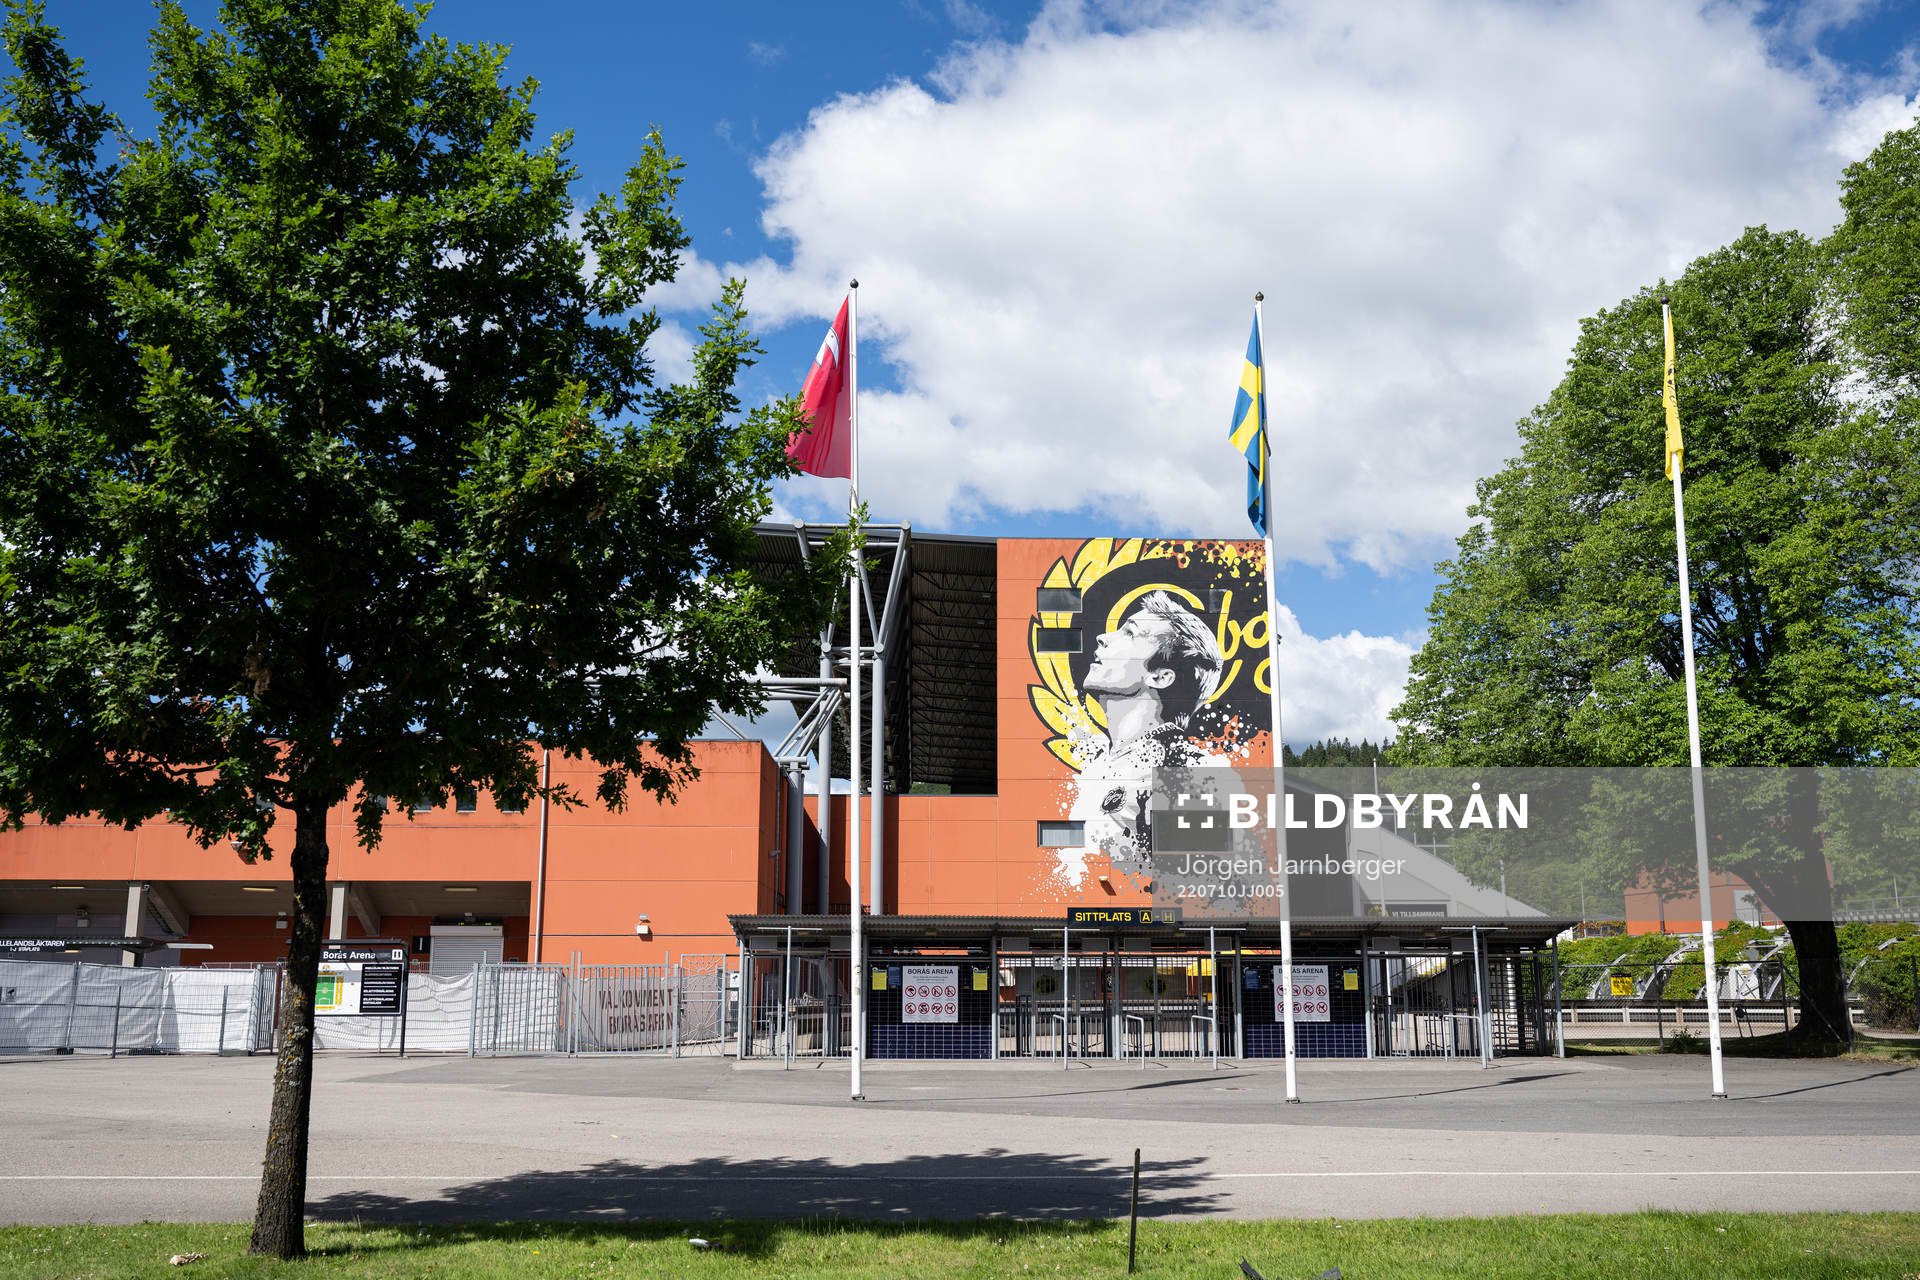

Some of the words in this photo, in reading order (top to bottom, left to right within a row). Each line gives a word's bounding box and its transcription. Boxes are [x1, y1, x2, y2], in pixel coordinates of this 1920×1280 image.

[1075, 912, 1132, 922] SITTPLATS
[323, 950, 347, 959] Borås
[349, 951, 376, 959] Arena
